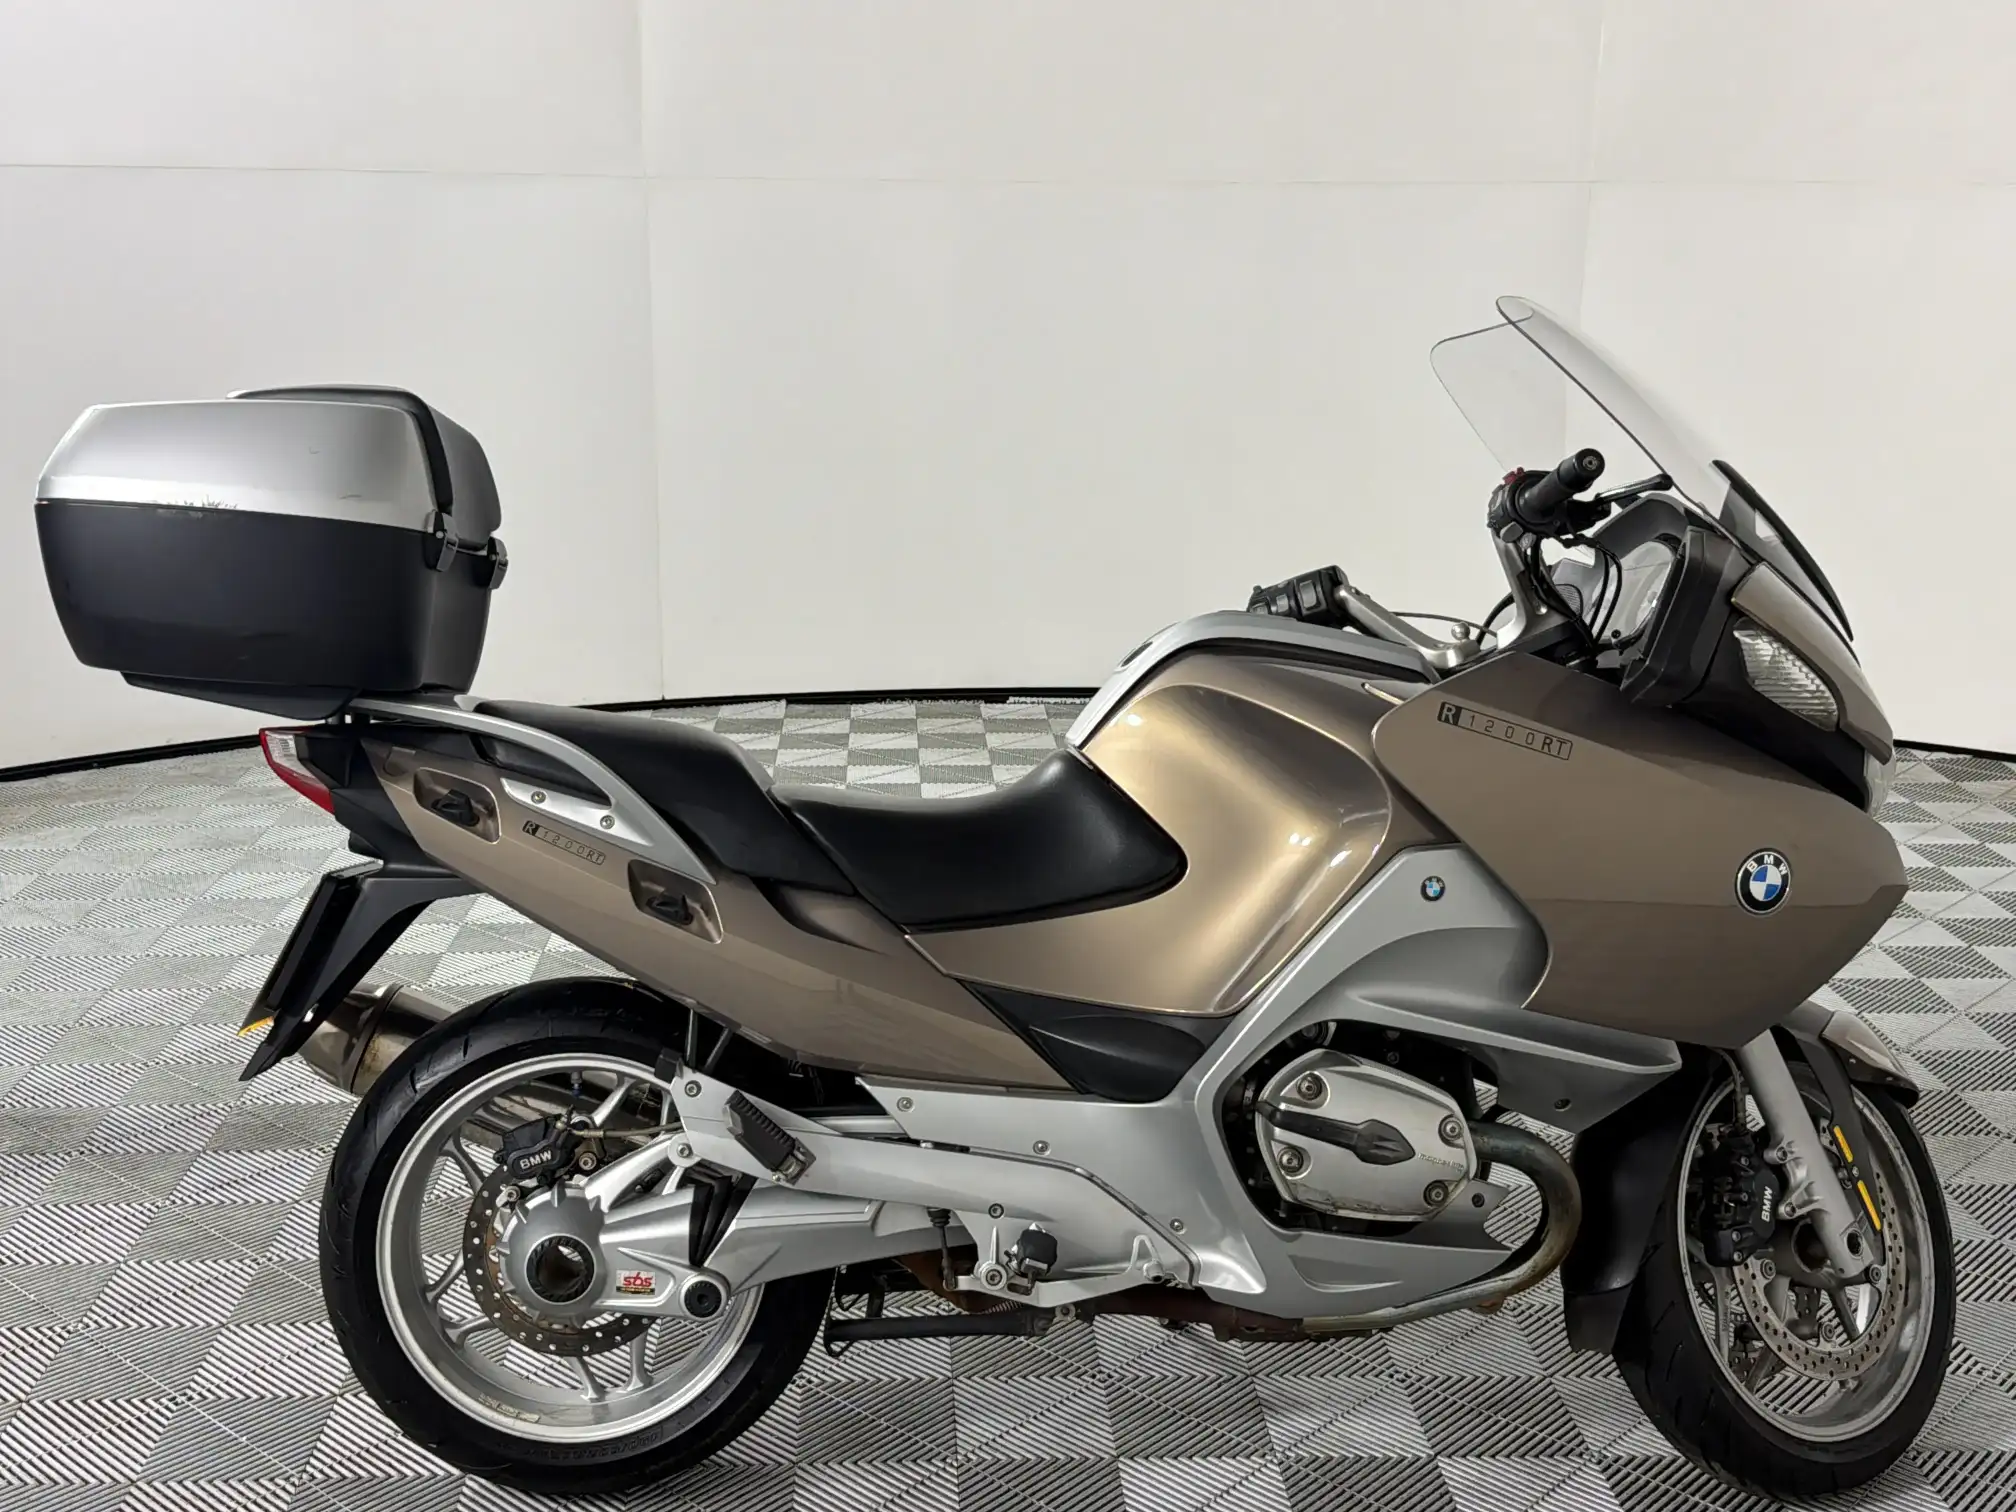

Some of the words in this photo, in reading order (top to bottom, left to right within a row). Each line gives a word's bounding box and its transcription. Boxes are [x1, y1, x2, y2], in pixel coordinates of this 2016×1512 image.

[1746, 854, 1788, 876] BMW
[520, 1150, 552, 1170] BMW
[1761, 1185, 1773, 1222] BMW
[623, 1272, 654, 1287] sbs
